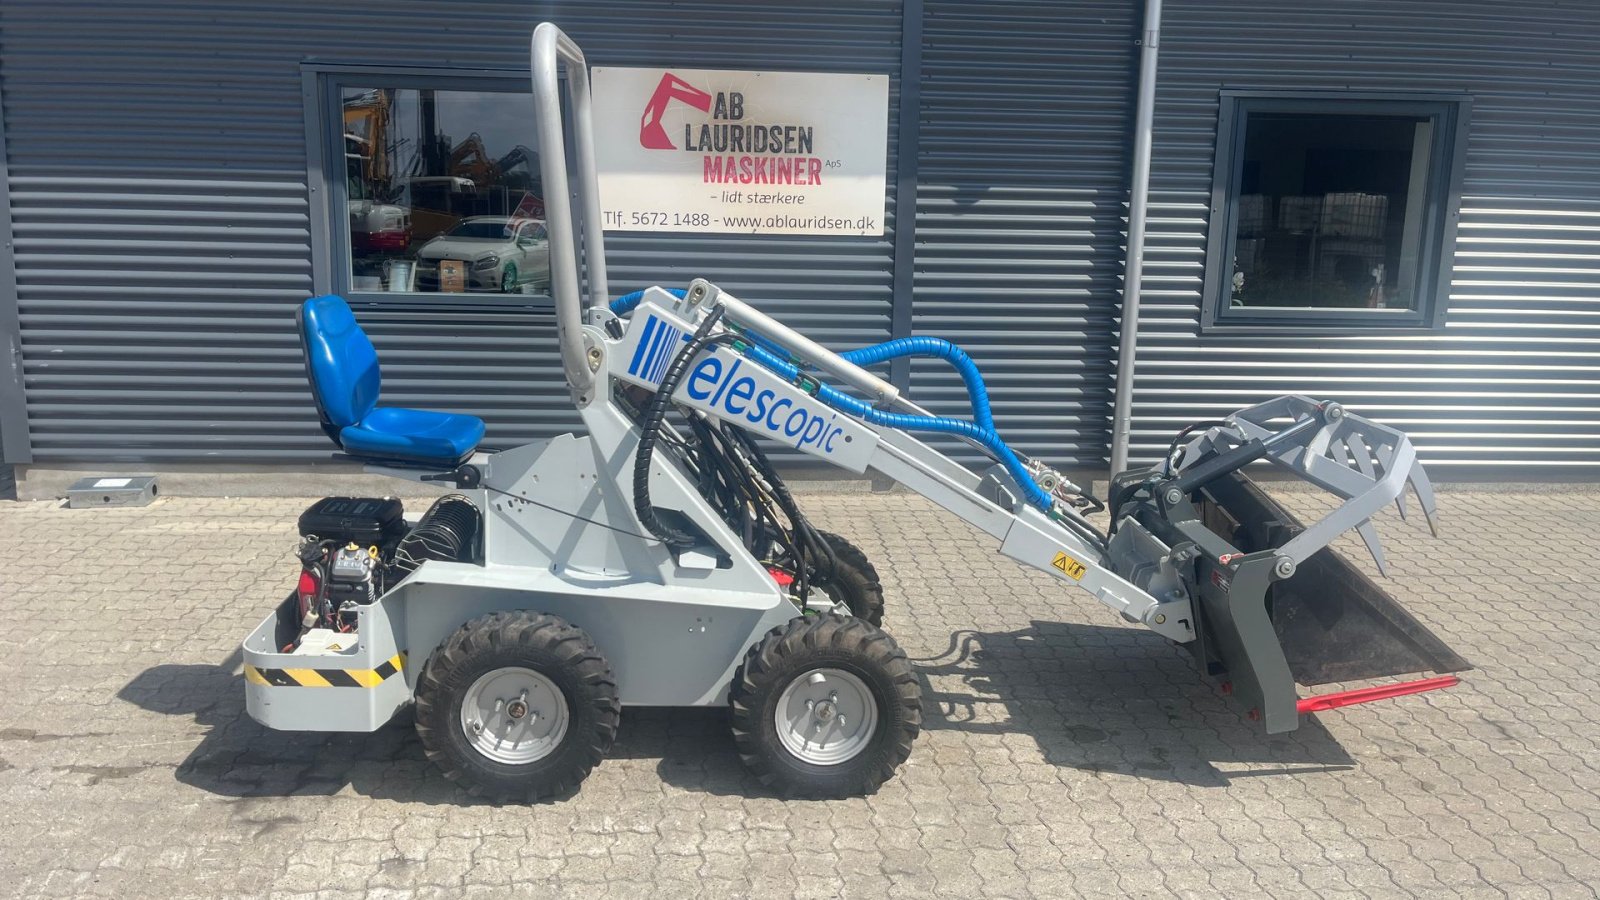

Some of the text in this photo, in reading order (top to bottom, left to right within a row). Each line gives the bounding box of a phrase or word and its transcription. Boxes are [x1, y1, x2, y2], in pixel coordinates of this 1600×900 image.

[714, 92, 744, 120] AB
[685, 124, 812, 154] LAURIDSEN
[703, 156, 842, 186] MASKINER ApS
[721, 191, 743, 204] lidt
[746, 193, 805, 205] stærkere
[603, 211, 627, 228] Tlf.
[631, 211, 668, 226] 5672
[673, 212, 710, 227] 1488
[723, 213, 875, 230] www.ablauridsen.dk
